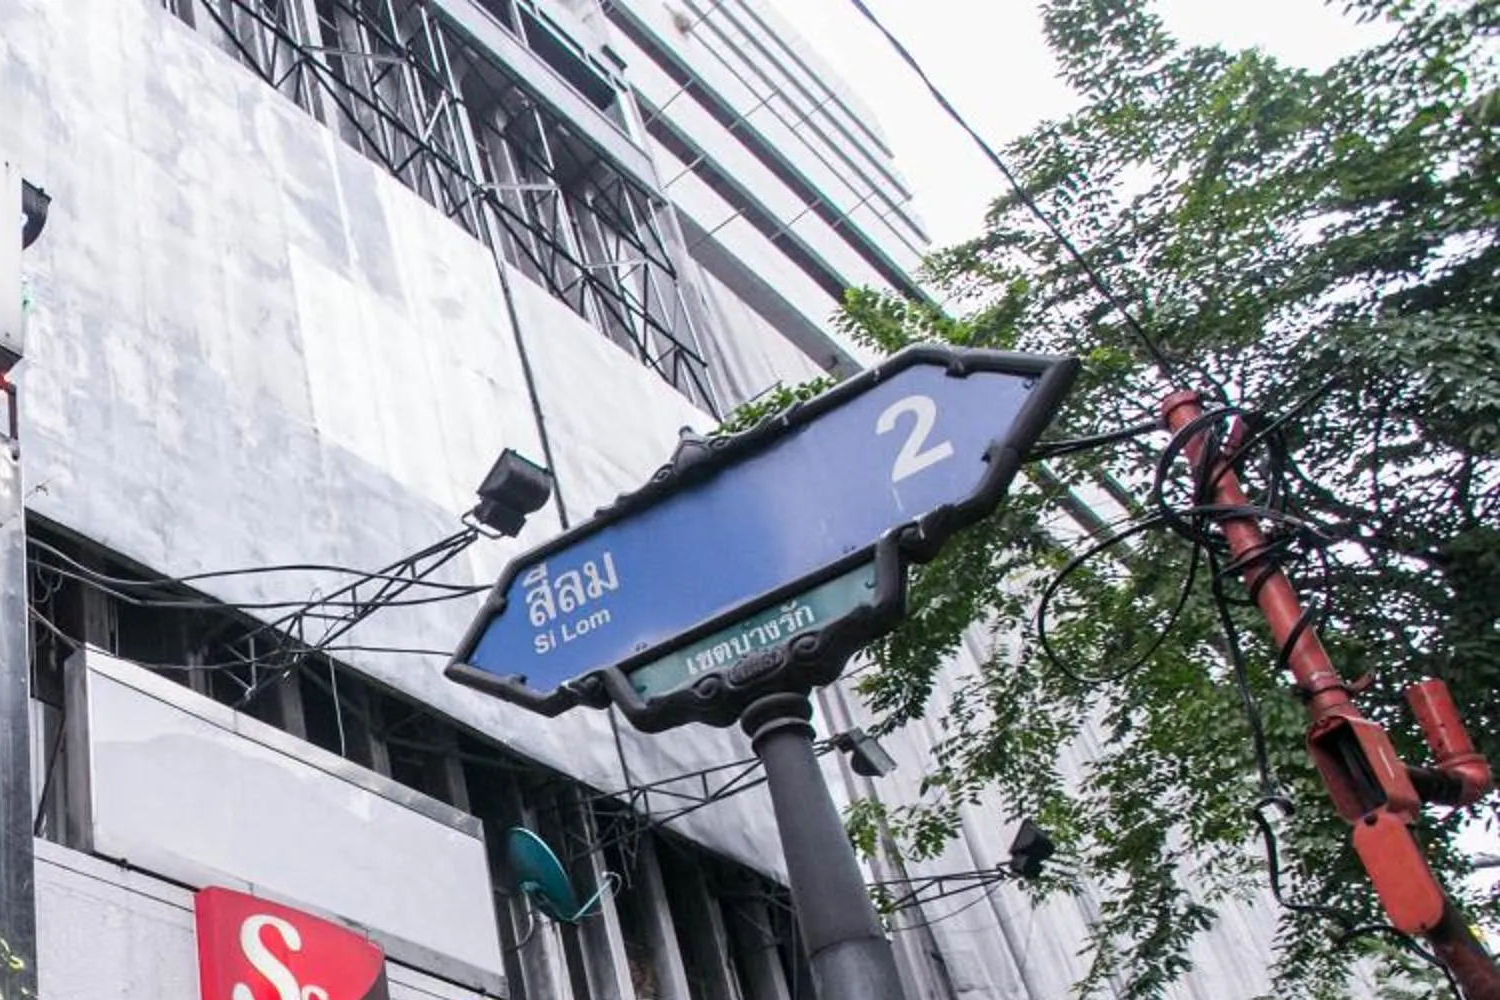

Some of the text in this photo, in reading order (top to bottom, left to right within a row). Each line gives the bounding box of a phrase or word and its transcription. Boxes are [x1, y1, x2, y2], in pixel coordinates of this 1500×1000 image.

[875, 394, 954, 482] 2
[521, 551, 620, 628] สีลม
[534, 607, 611, 655] Si Lom
[686, 601, 816, 675] เขตบางรัก
